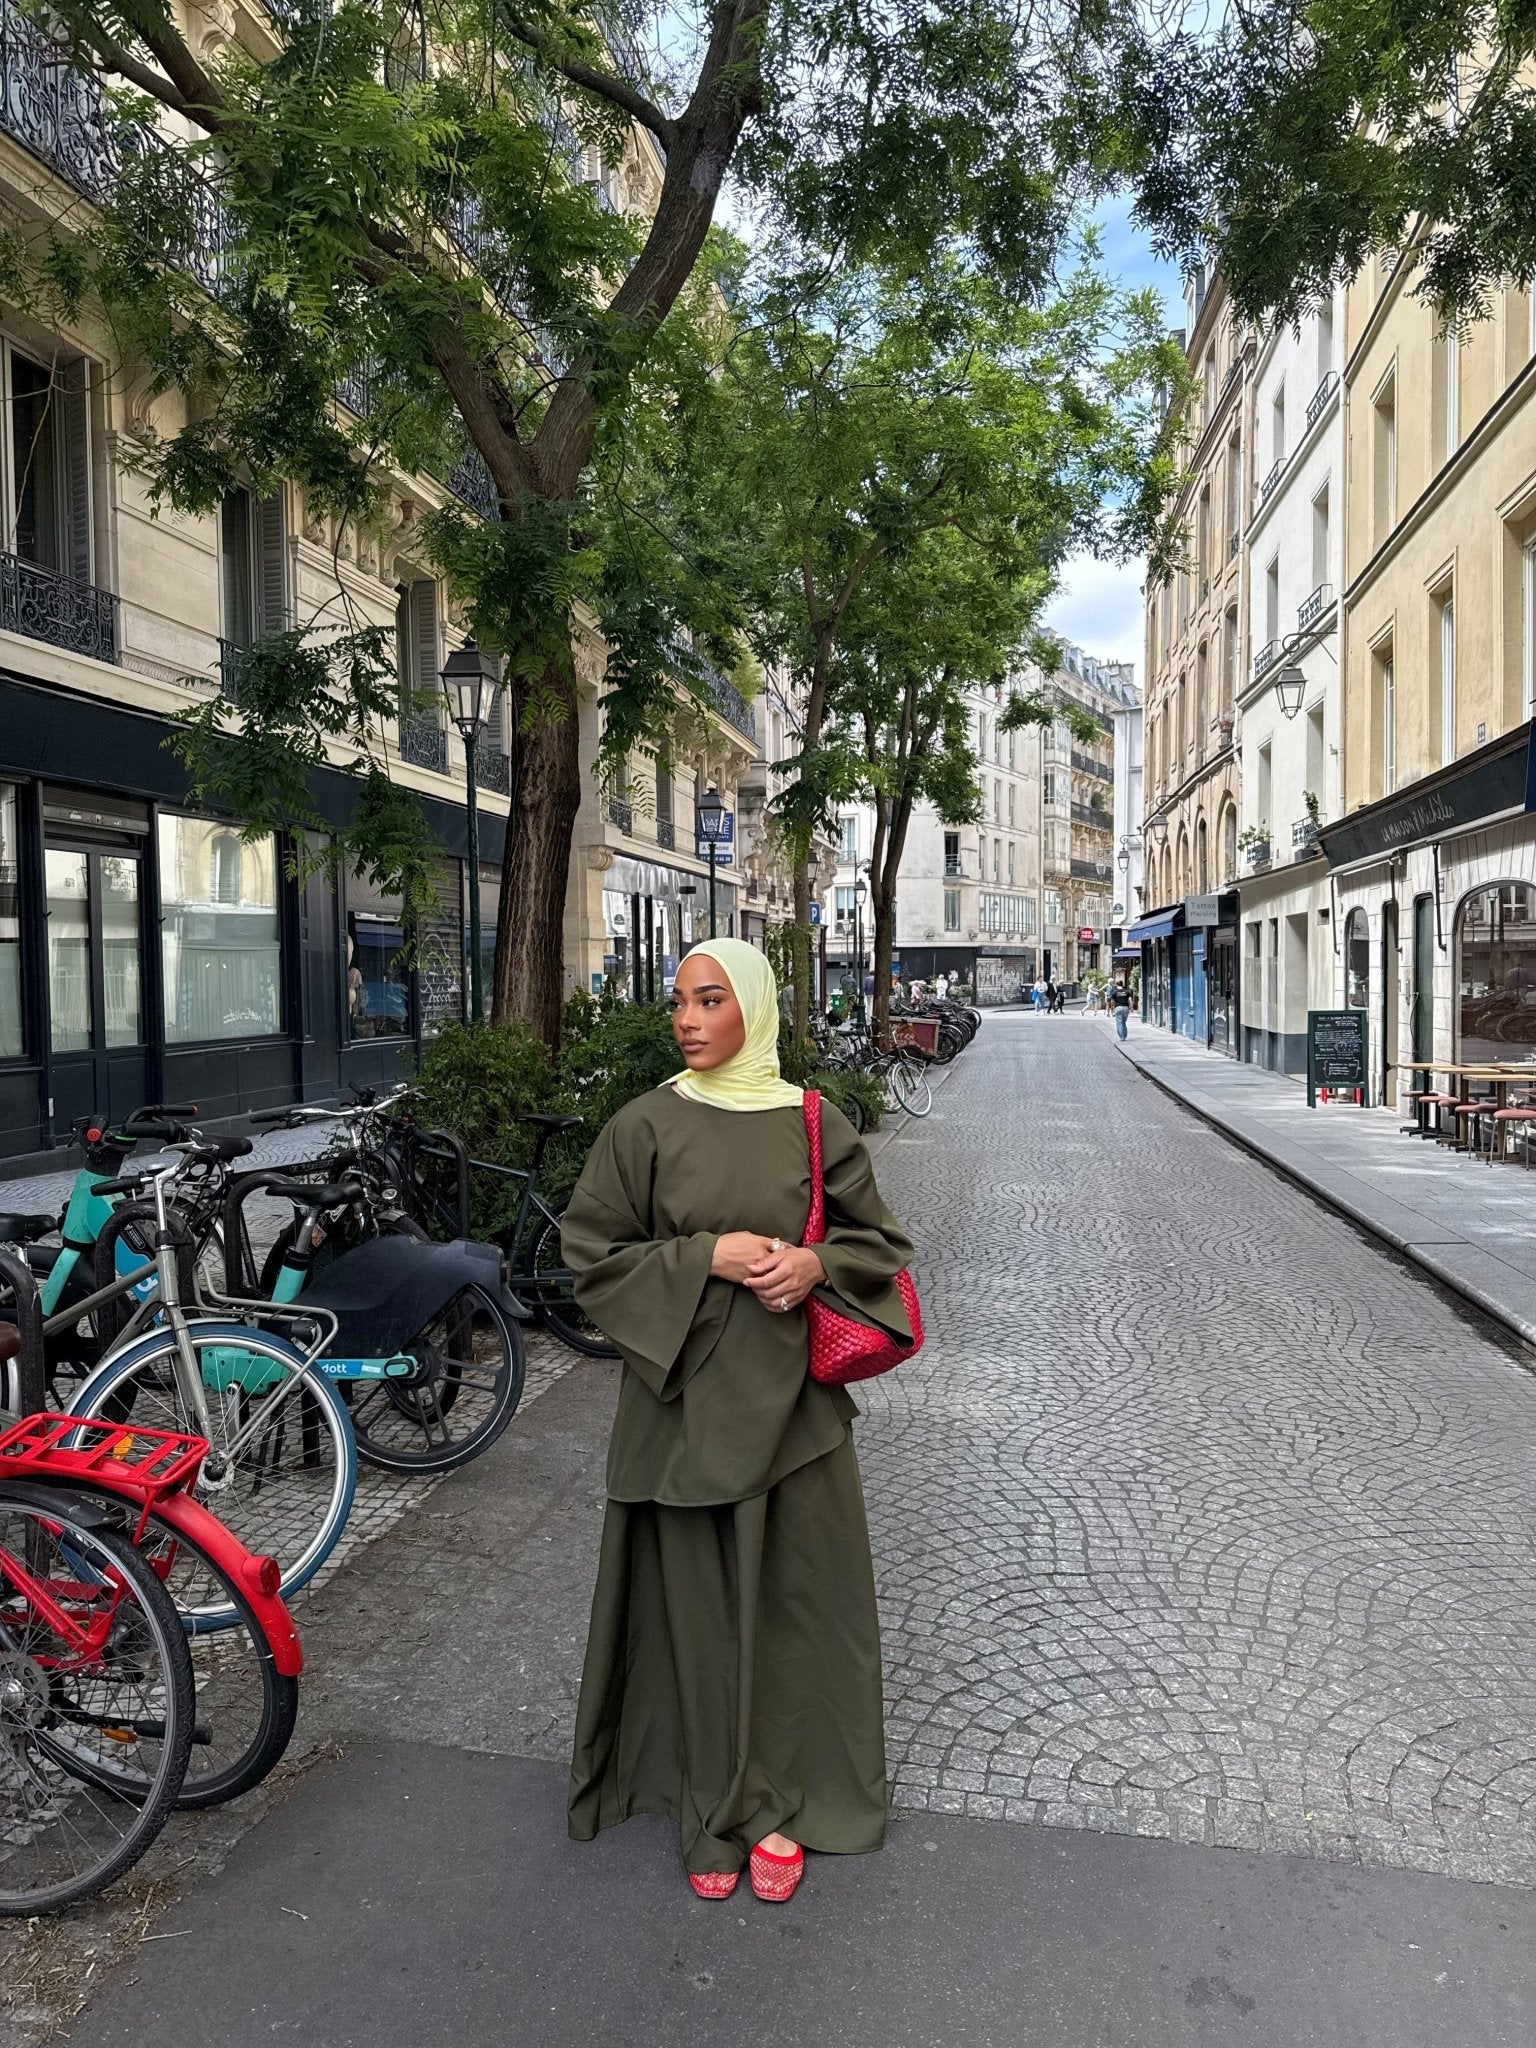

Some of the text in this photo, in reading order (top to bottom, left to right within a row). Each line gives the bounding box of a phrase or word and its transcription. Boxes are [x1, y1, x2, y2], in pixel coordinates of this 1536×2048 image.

[1389, 815, 1416, 840] MAISON
[1190, 902, 1216, 910] Tattoo
[811, 906, 818, 921] P
[1190, 910, 1217, 919] Piercing
[321, 1363, 348, 1374] dott
